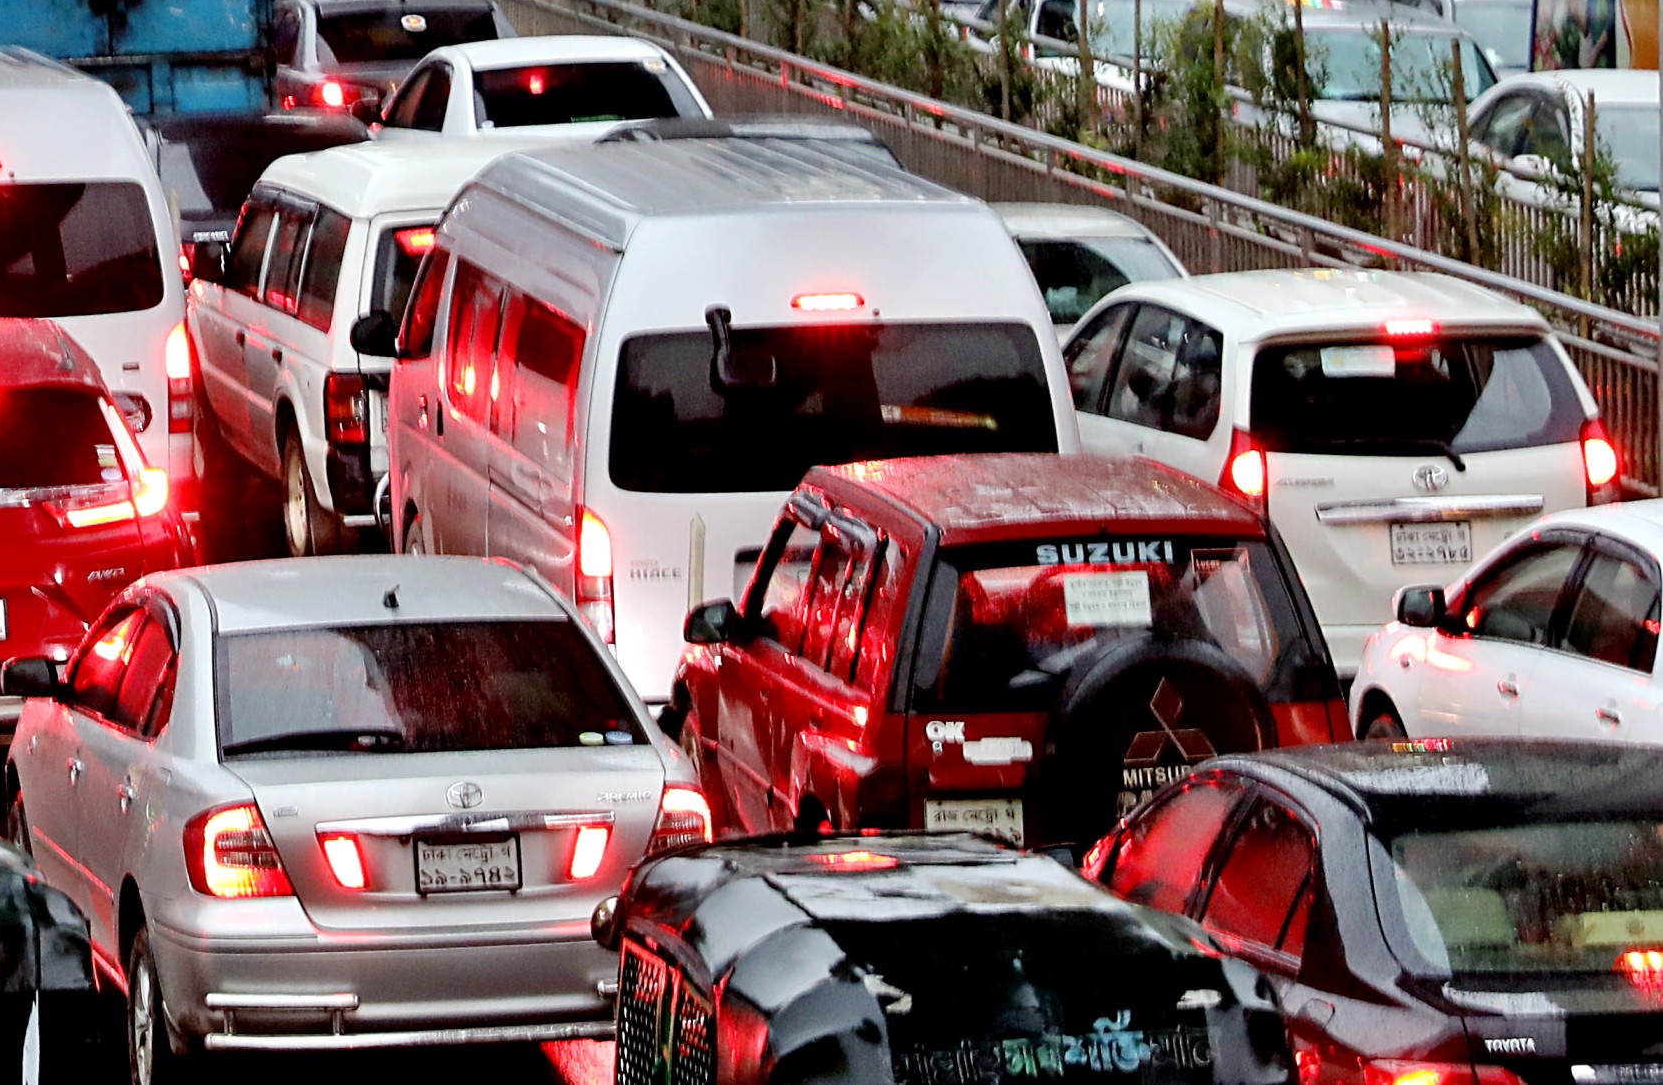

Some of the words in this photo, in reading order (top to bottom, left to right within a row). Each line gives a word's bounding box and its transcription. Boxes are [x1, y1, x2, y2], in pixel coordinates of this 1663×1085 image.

[1036, 540, 1174, 566] SUZUKI
[630, 567, 682, 578] HIACE
[925, 720, 966, 744] OK
[423, 847, 451, 862] ঢাকা
